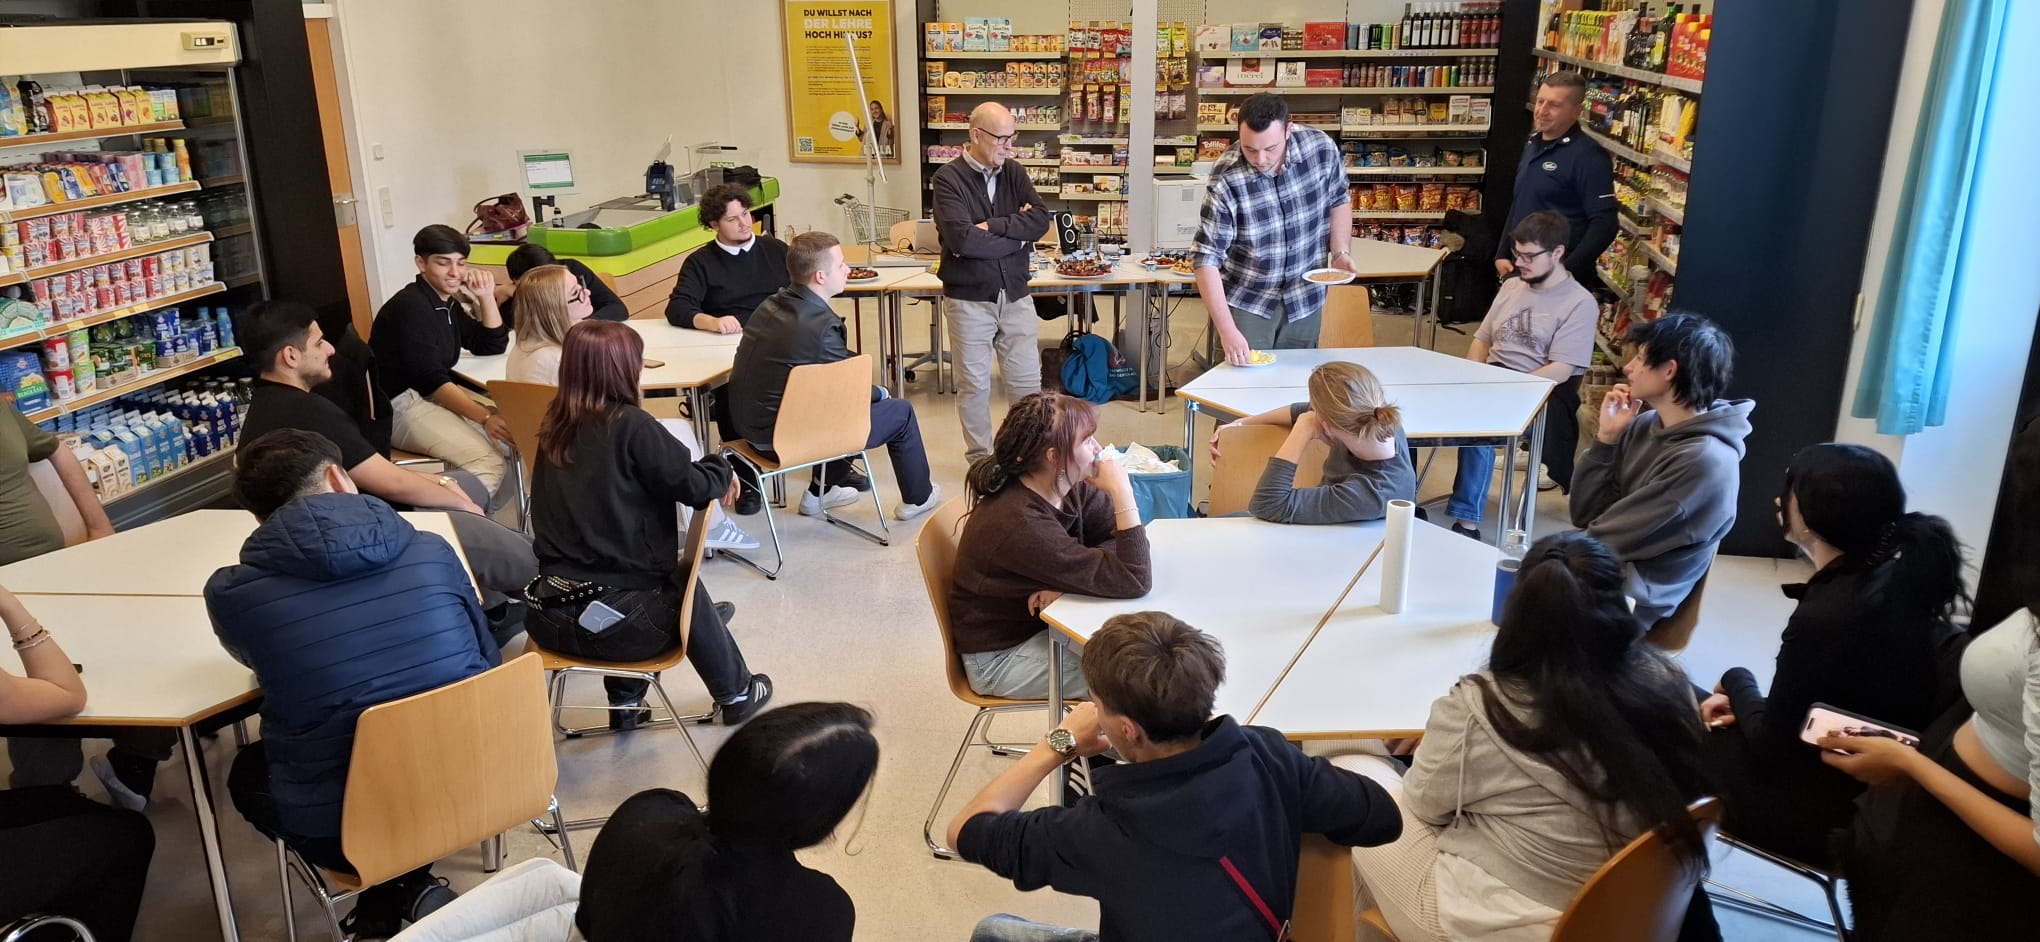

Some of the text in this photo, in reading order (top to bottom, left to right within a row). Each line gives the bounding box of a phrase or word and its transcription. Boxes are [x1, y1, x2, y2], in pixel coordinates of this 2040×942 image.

[804, 18, 872, 28] DER LEHRE
[805, 31, 872, 39] HOCH HIUS?
